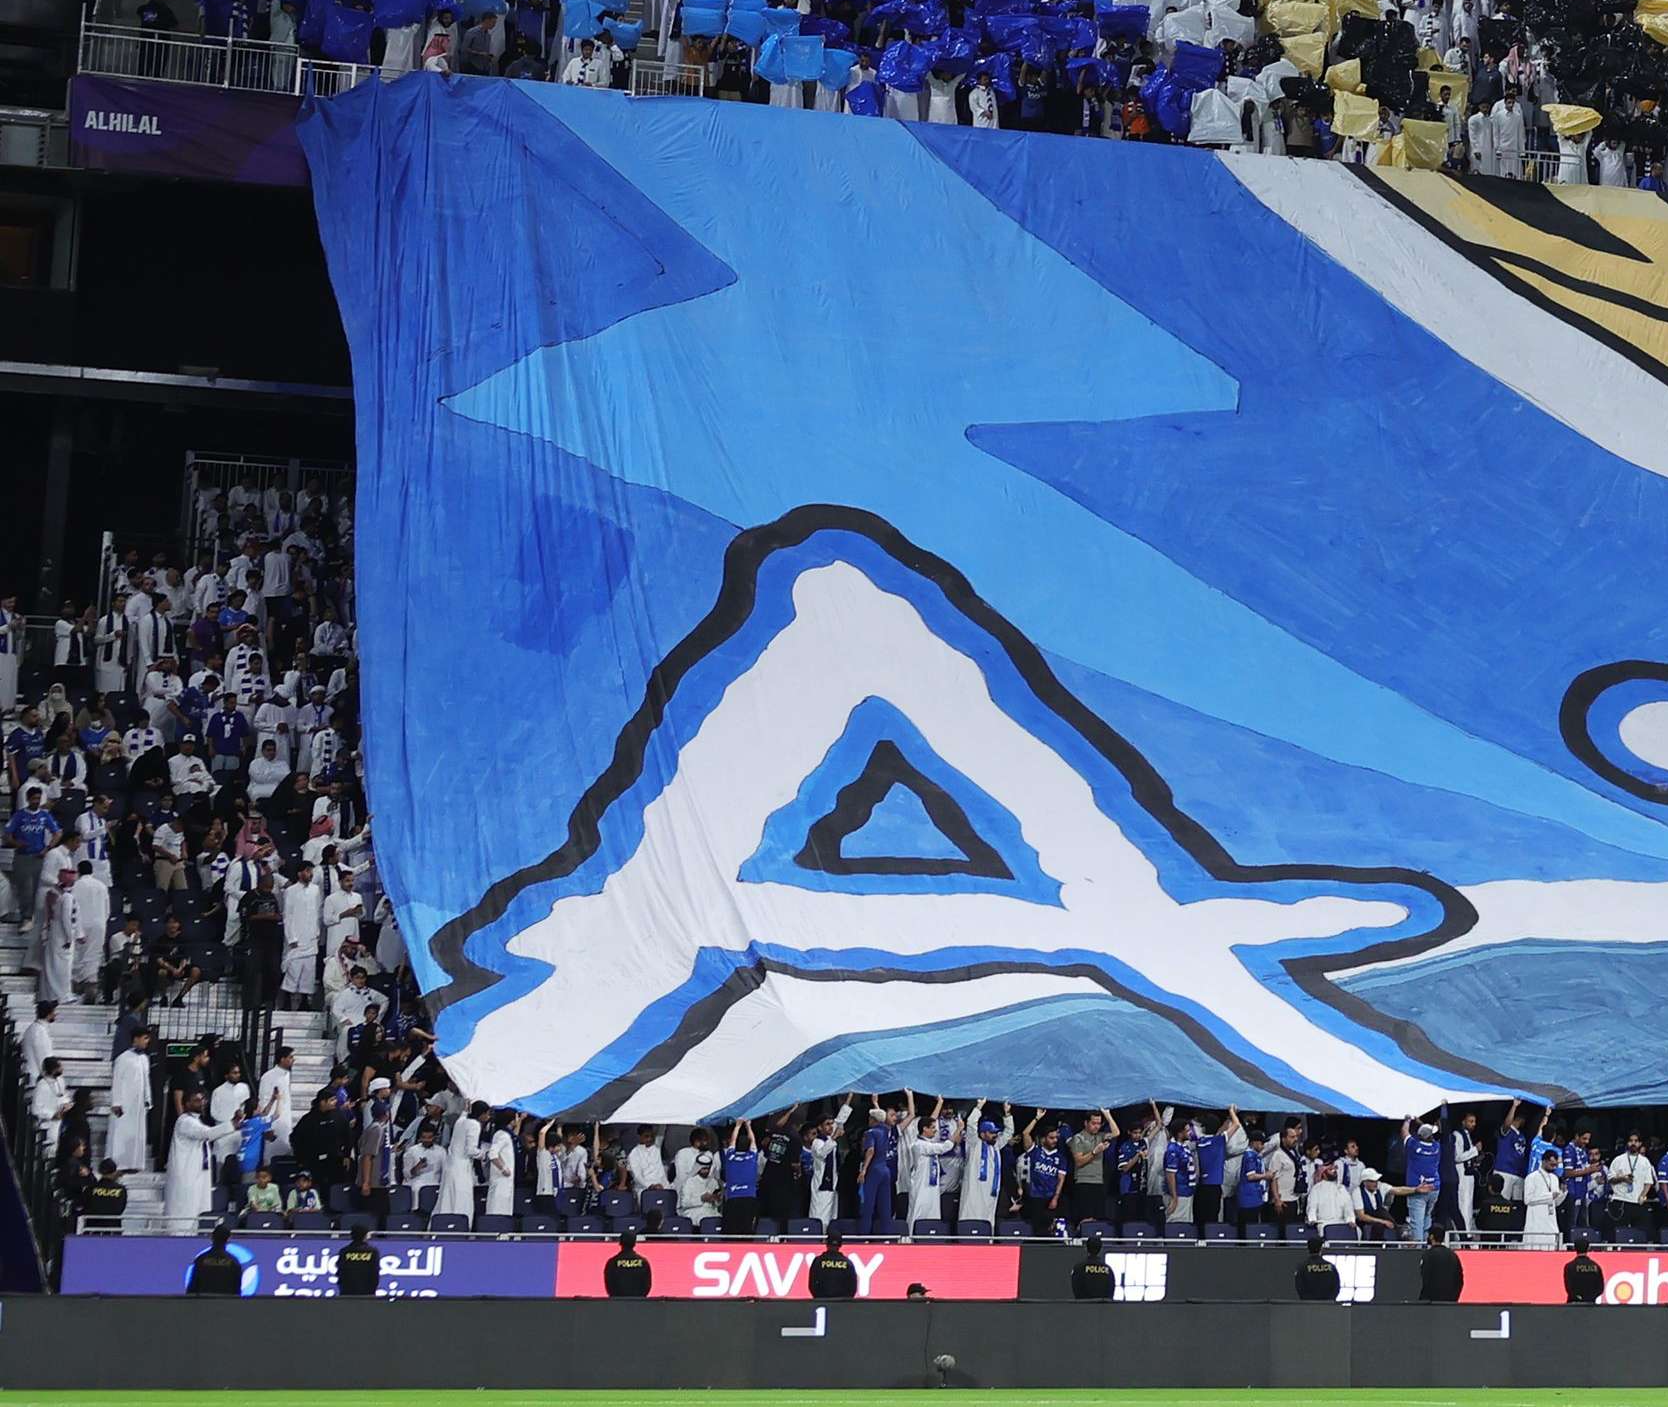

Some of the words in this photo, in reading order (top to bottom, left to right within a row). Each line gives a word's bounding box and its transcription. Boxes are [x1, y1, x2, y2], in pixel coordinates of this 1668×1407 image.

[85, 110, 162, 135] ALHILAL
[1490, 1205, 1511, 1213] POLICE
[345, 1252, 373, 1261] POLICE
[617, 1259, 643, 1268] POLICE
[821, 1260, 848, 1270] POLICE
[1085, 1265, 1110, 1274] POLICE
[1307, 1264, 1333, 1273] POLICE
[1575, 1265, 1599, 1273] POLICE
[692, 1252, 884, 1298] SAVY
